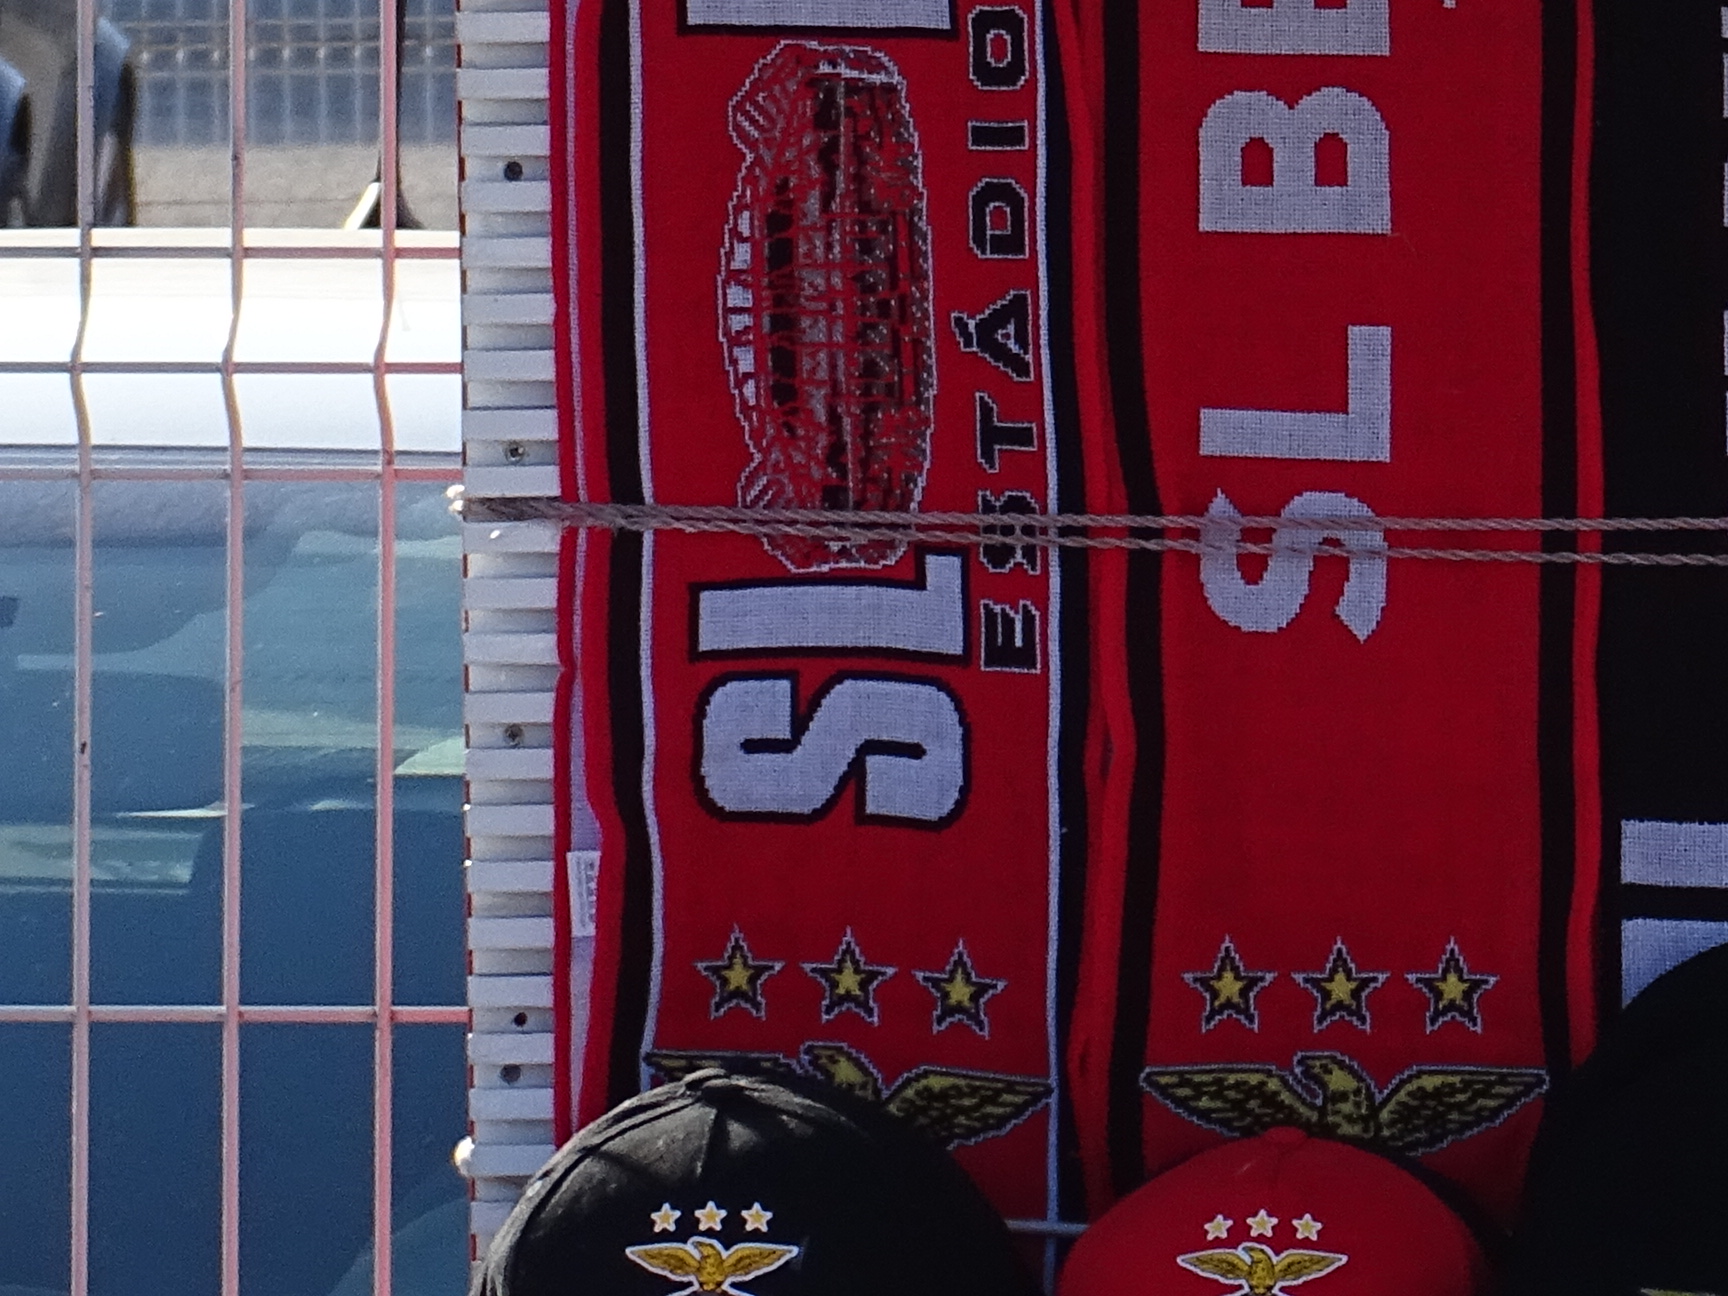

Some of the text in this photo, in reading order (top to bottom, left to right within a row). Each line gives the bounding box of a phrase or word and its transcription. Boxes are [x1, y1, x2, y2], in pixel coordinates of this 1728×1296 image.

[952, 5, 1042, 674] ESTÁDIO
[1198, 324, 1391, 643] SL
[691, 548, 972, 825] SL
